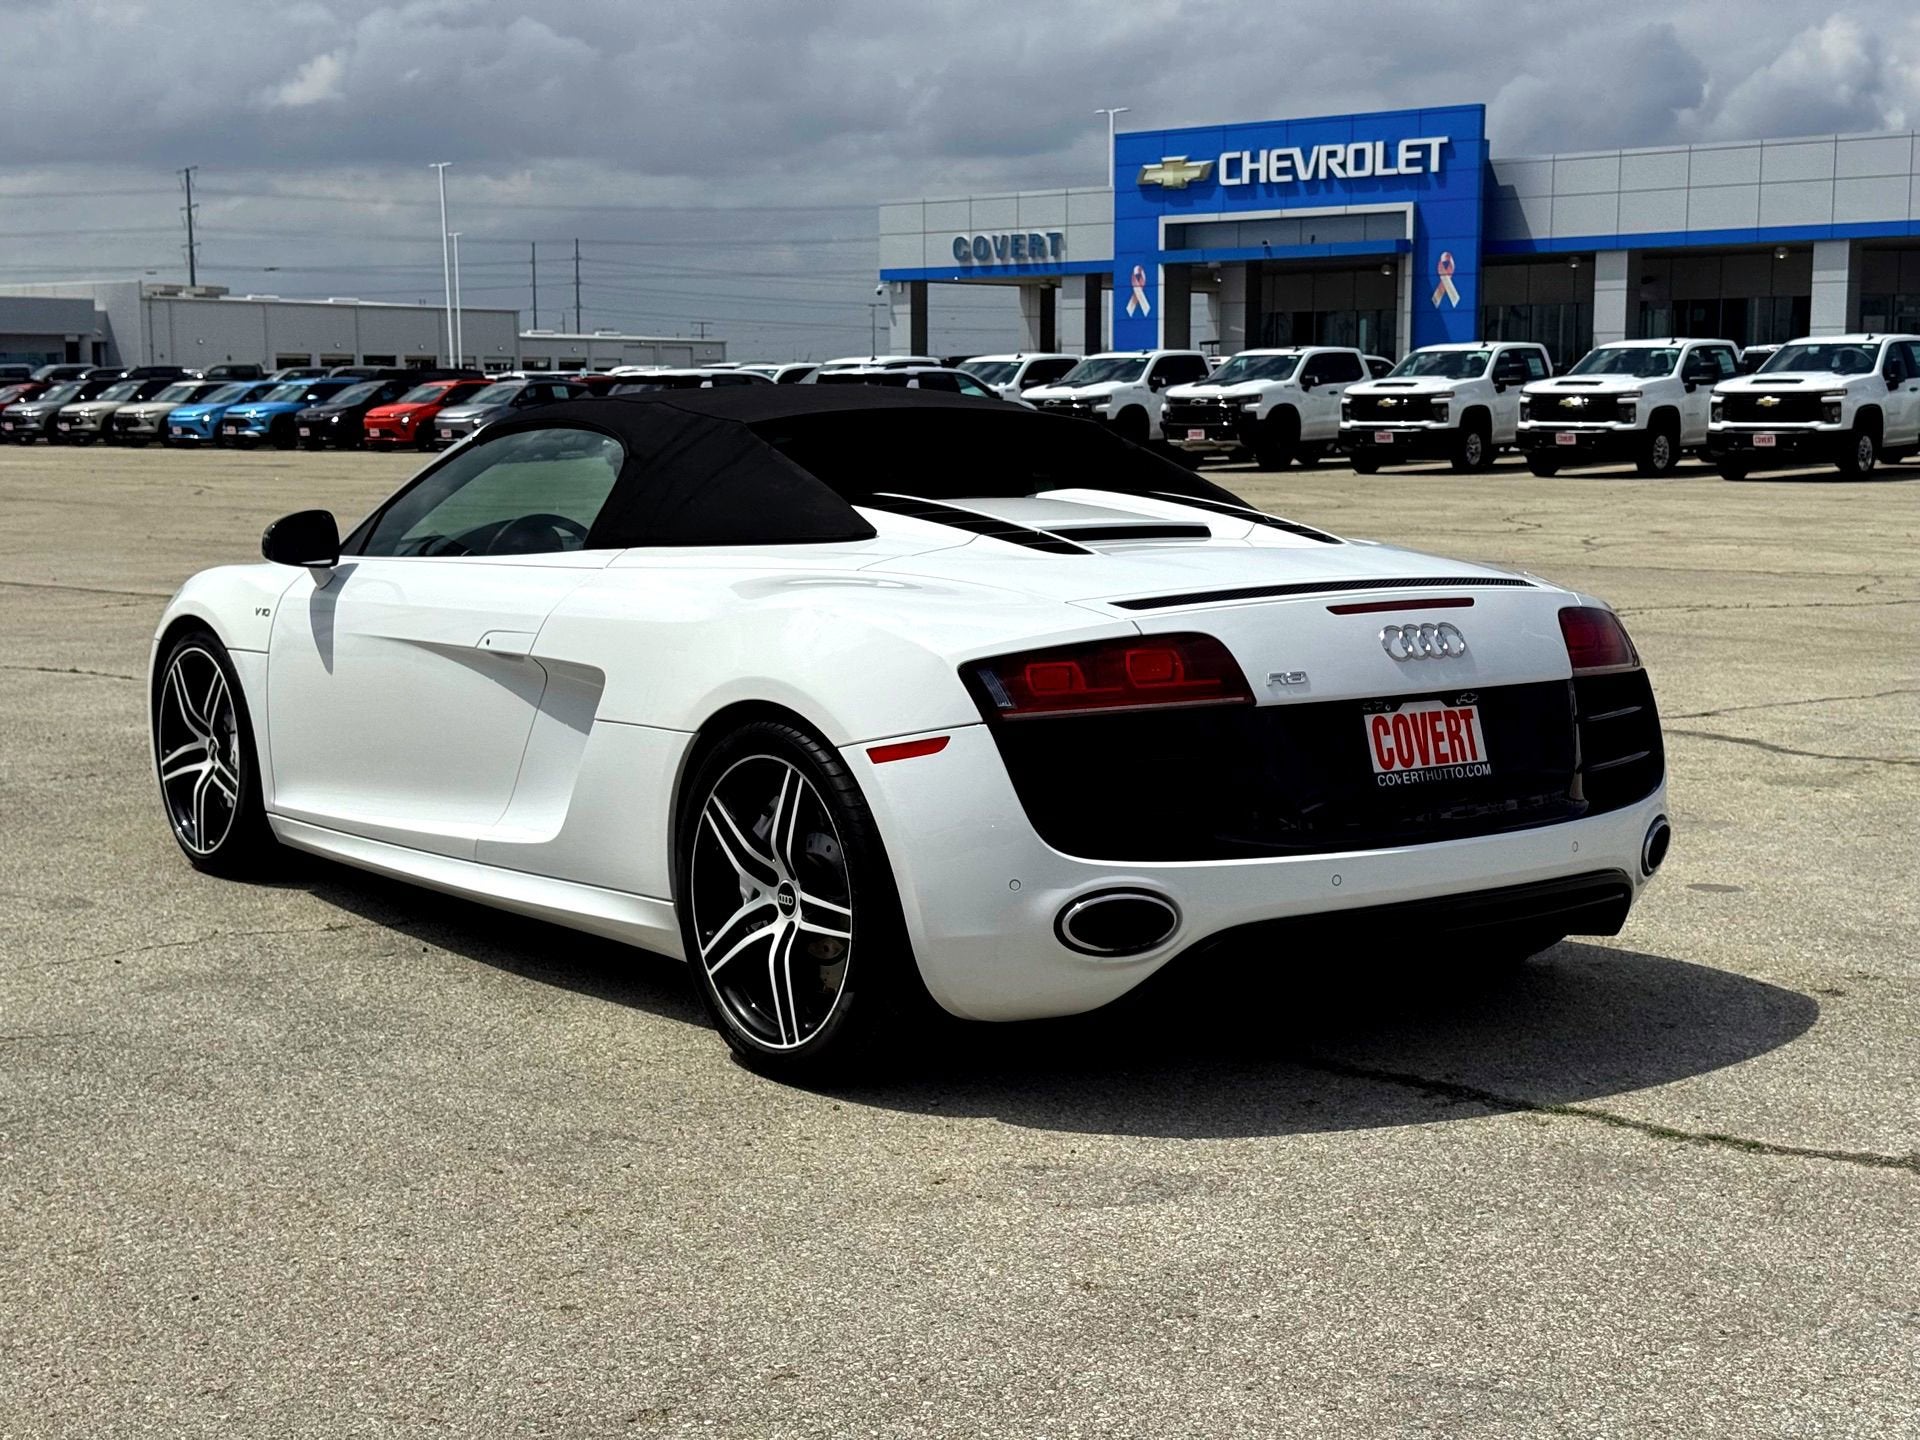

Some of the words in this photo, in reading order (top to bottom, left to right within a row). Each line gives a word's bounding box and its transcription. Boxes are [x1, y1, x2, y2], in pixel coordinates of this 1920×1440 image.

[1219, 136, 1449, 186] CHEVROLET
[952, 231, 1065, 262] COVERT
[255, 607, 271, 617] V10
[1265, 671, 1307, 687] R8
[1372, 708, 1478, 771] COVERT
[1377, 763, 1492, 787] COVERTHUTTO.COM
